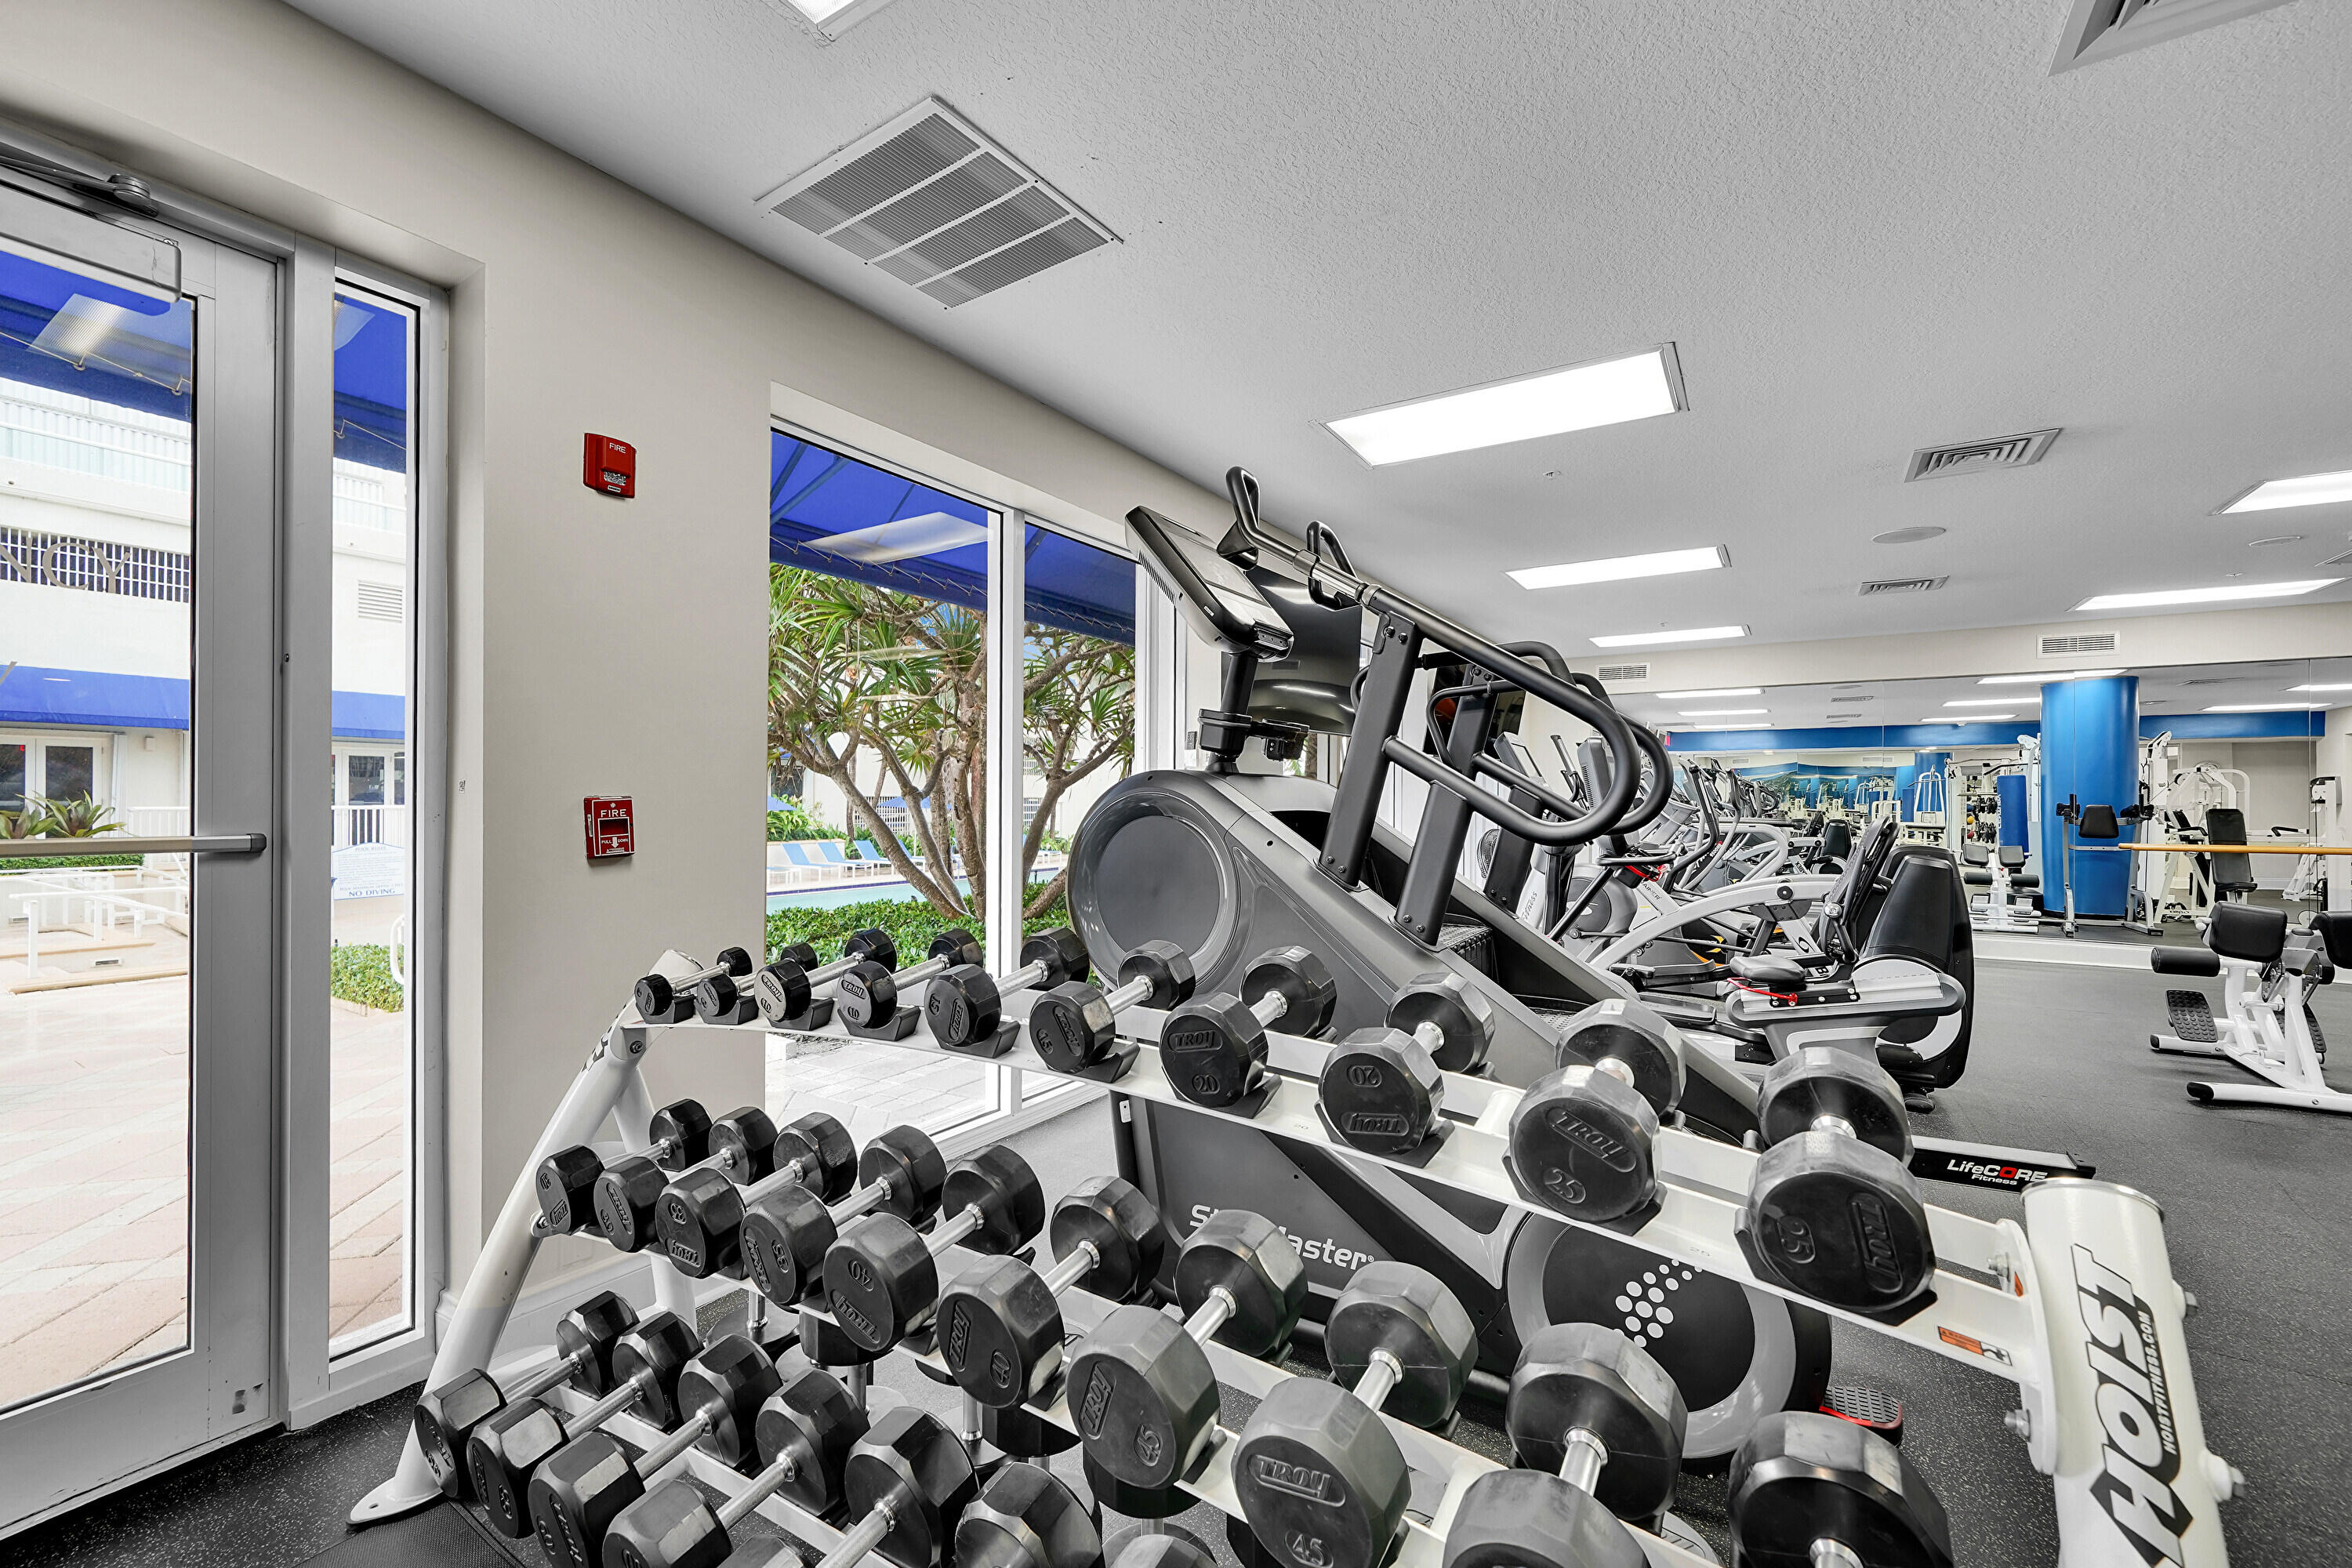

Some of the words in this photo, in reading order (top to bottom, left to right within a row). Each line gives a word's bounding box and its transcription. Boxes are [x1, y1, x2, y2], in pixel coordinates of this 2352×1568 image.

[608, 442, 626, 454] FIRE
[601, 808, 627, 818] FIRE
[844, 981, 866, 1000] TROY
[849, 1007, 860, 1020] 10
[1039, 1029, 1053, 1054] 15
[1174, 1030, 1216, 1049] TROY
[1193, 1074, 1218, 1093] 20
[1348, 1066, 1378, 1086] 20
[1551, 1110, 1631, 1160] TROY
[1544, 1167, 1584, 1200] 25
[1947, 1159, 2048, 1182] LifeCORE
[1971, 1174, 2018, 1185] Fitness
[1851, 1202, 1901, 1282] TROY
[836, 1295, 878, 1340] TROY
[949, 1304, 971, 1365] TROY
[991, 1351, 1011, 1383] 40
[2136, 1310, 2177, 1455] HOISTFITNESS.COM
[1081, 1364, 1114, 1433] TROY
[2071, 1243, 2184, 1568] HOIST
[1137, 1424, 1160, 1460] 45
[1255, 1454, 1331, 1500] TROY
[1292, 1534, 1325, 1566] 45
